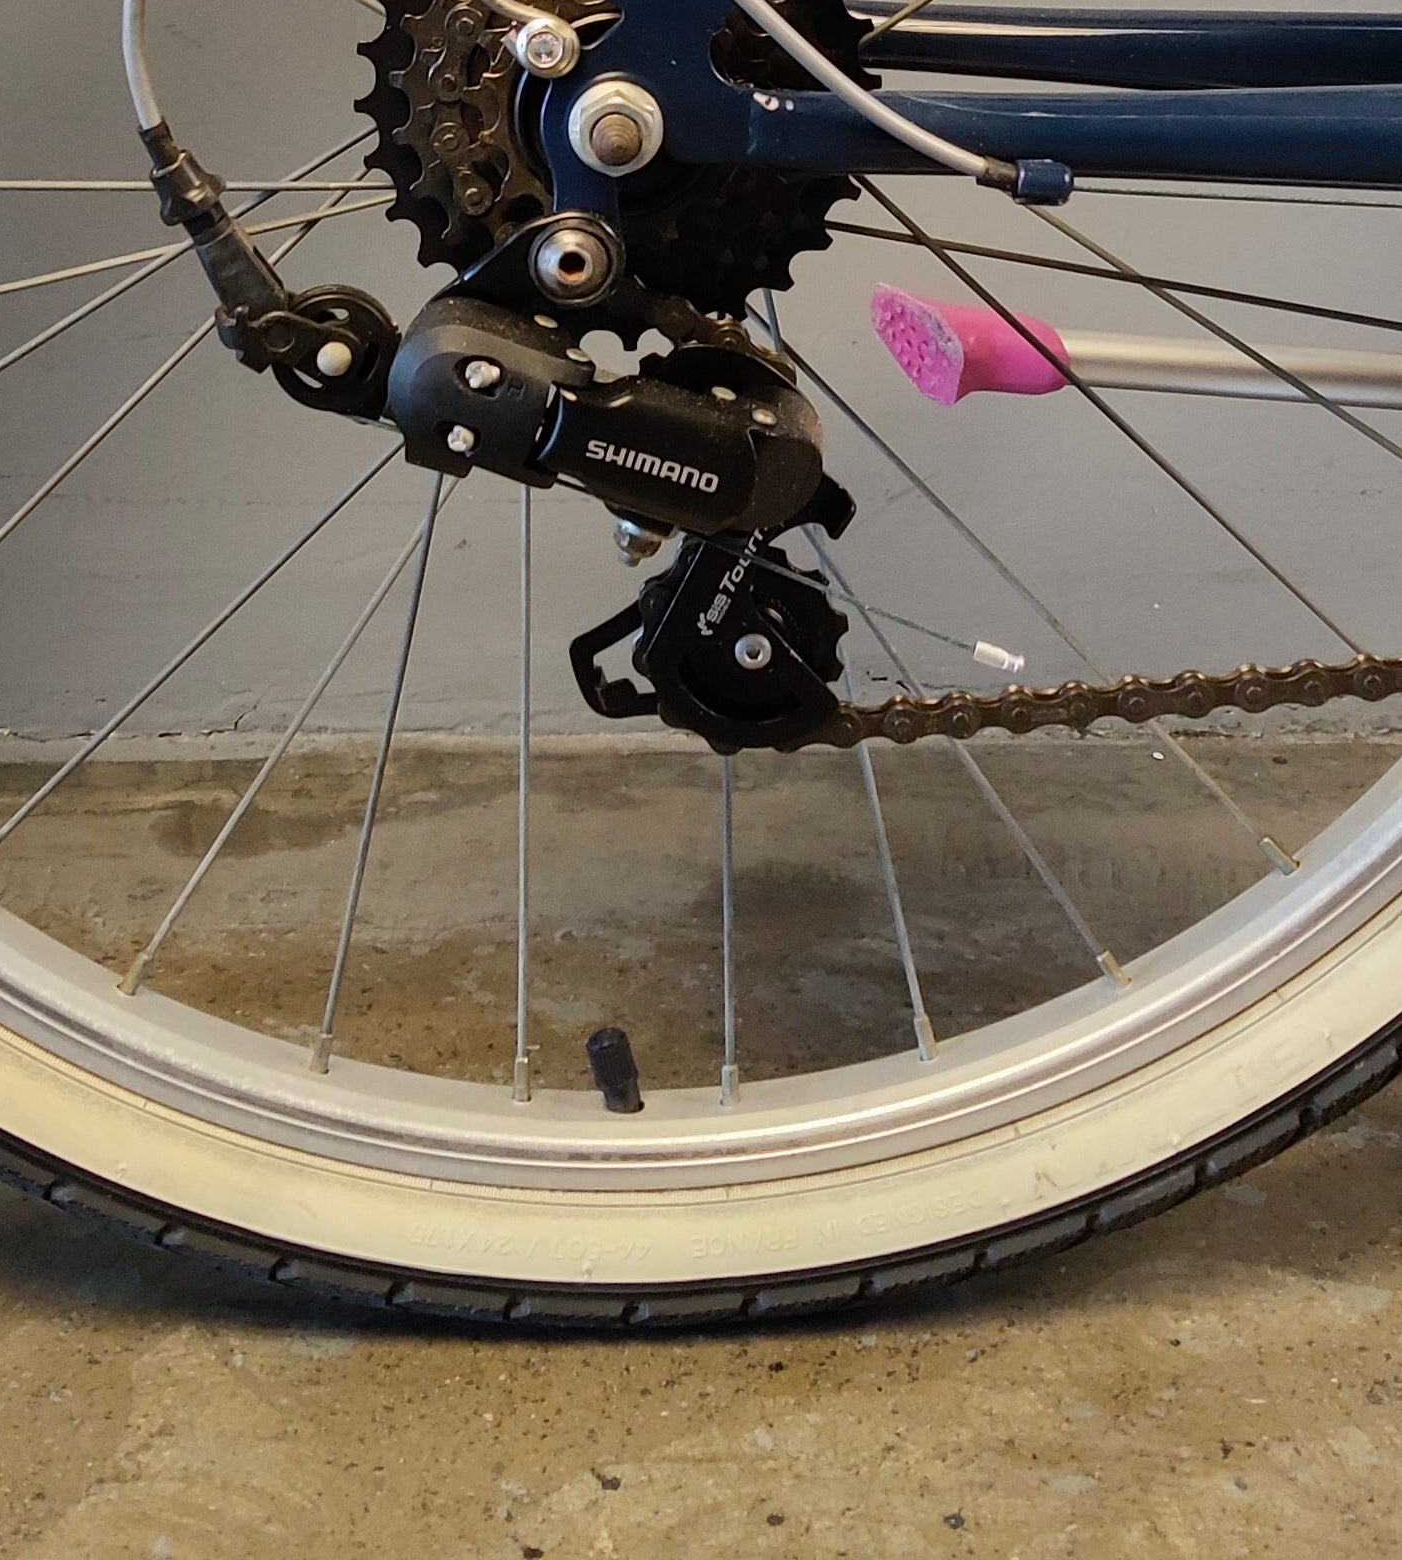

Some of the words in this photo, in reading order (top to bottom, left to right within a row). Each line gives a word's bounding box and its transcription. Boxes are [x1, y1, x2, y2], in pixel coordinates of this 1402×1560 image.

[586, 439, 719, 493] SHIMANO
[852, 1186, 985, 1241] DESIGNED
[691, 1224, 800, 1262] FRANCE
